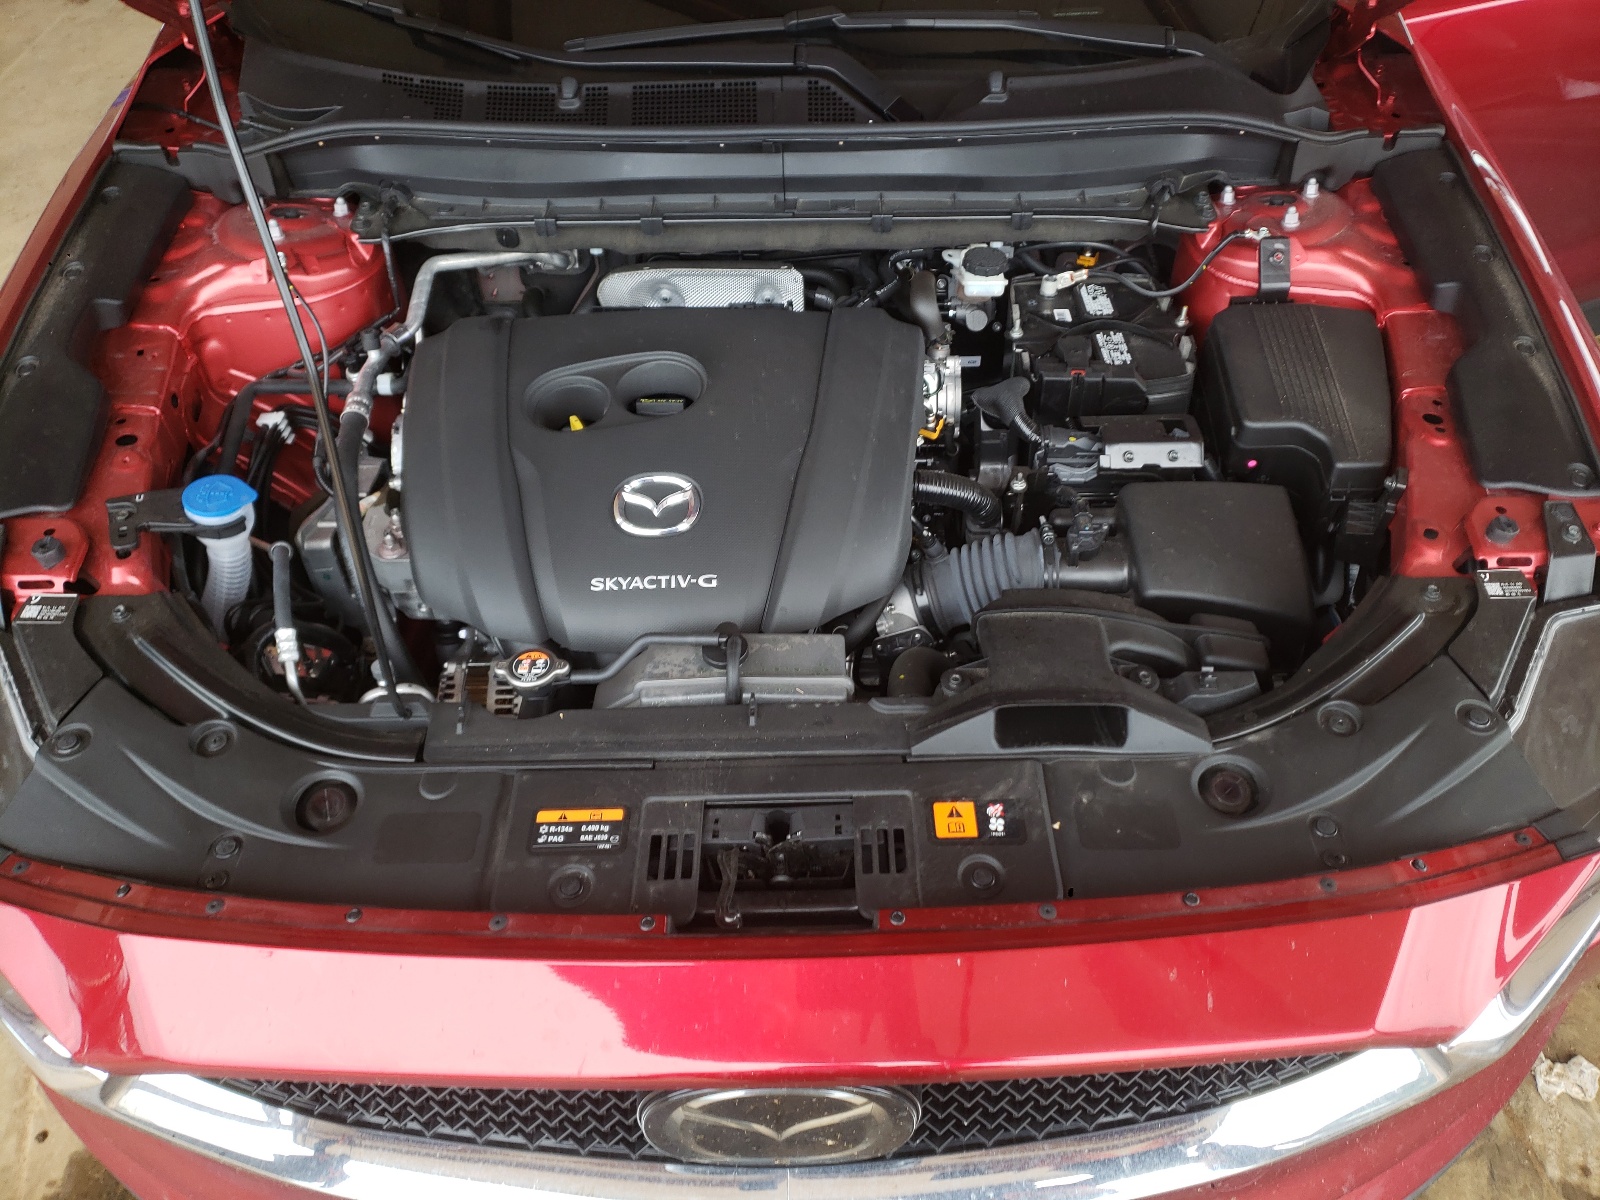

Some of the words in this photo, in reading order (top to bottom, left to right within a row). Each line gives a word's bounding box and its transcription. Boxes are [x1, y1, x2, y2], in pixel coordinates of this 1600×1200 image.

[590, 574, 718, 591] SKYACTIV-G
[600, 824, 610, 833] kg
[547, 835, 564, 843] PAG
